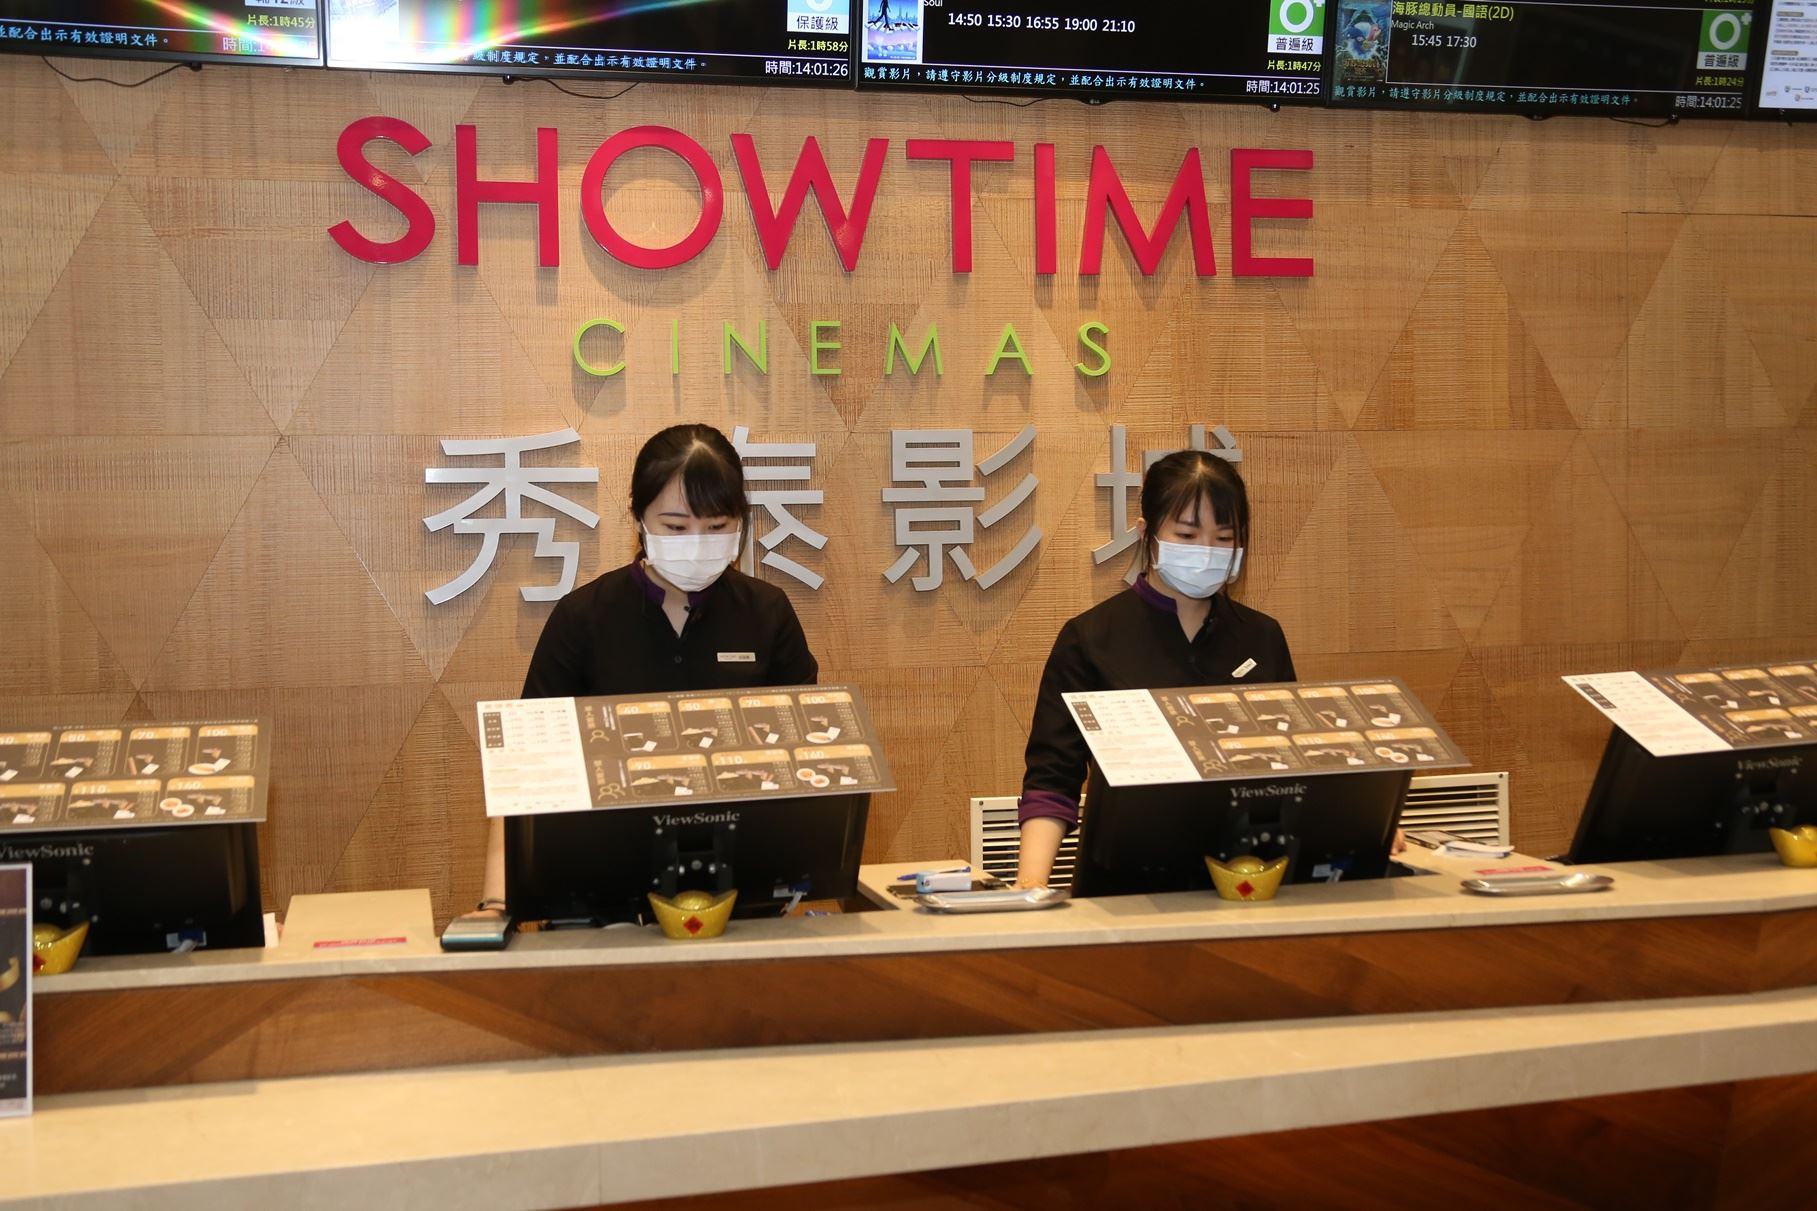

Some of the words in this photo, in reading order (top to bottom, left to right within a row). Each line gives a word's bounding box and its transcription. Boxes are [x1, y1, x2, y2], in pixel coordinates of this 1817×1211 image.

[1392, 1, 1515, 22] 海豚總動員-國語(2D)
[247, 14, 316, 29] 片長:1時45分
[796, 15, 839, 31] 保護級
[948, 12, 983, 26] 14:50
[987, 14, 1021, 28] 15:30
[1026, 16, 1060, 30] 16:55
[1064, 17, 1098, 31] 19:00
[1102, 19, 1136, 33] 21:10
[1391, 19, 1414, 31] Magic
[1416, 20, 1435, 30] Arch
[787, 39, 849, 53] 片長:1時58分
[1275, 37, 1314, 52] 普遍級
[1411, 34, 1442, 47] 15:45
[1446, 36, 1477, 48] 17:30
[765, 60, 849, 77] 時間:14:01:26
[1267, 60, 1322, 73] 片長:1時47分
[1246, 80, 1321, 96] 時間:14:01:25
[1674, 95, 1743, 110] 時間:14:01:25
[327, 115, 1316, 279] SHOWTIME
[573, 318, 1113, 377] CINEMAS
[1230, 783, 1307, 798] ViewSonic
[653, 811, 740, 826] ViewSonic
